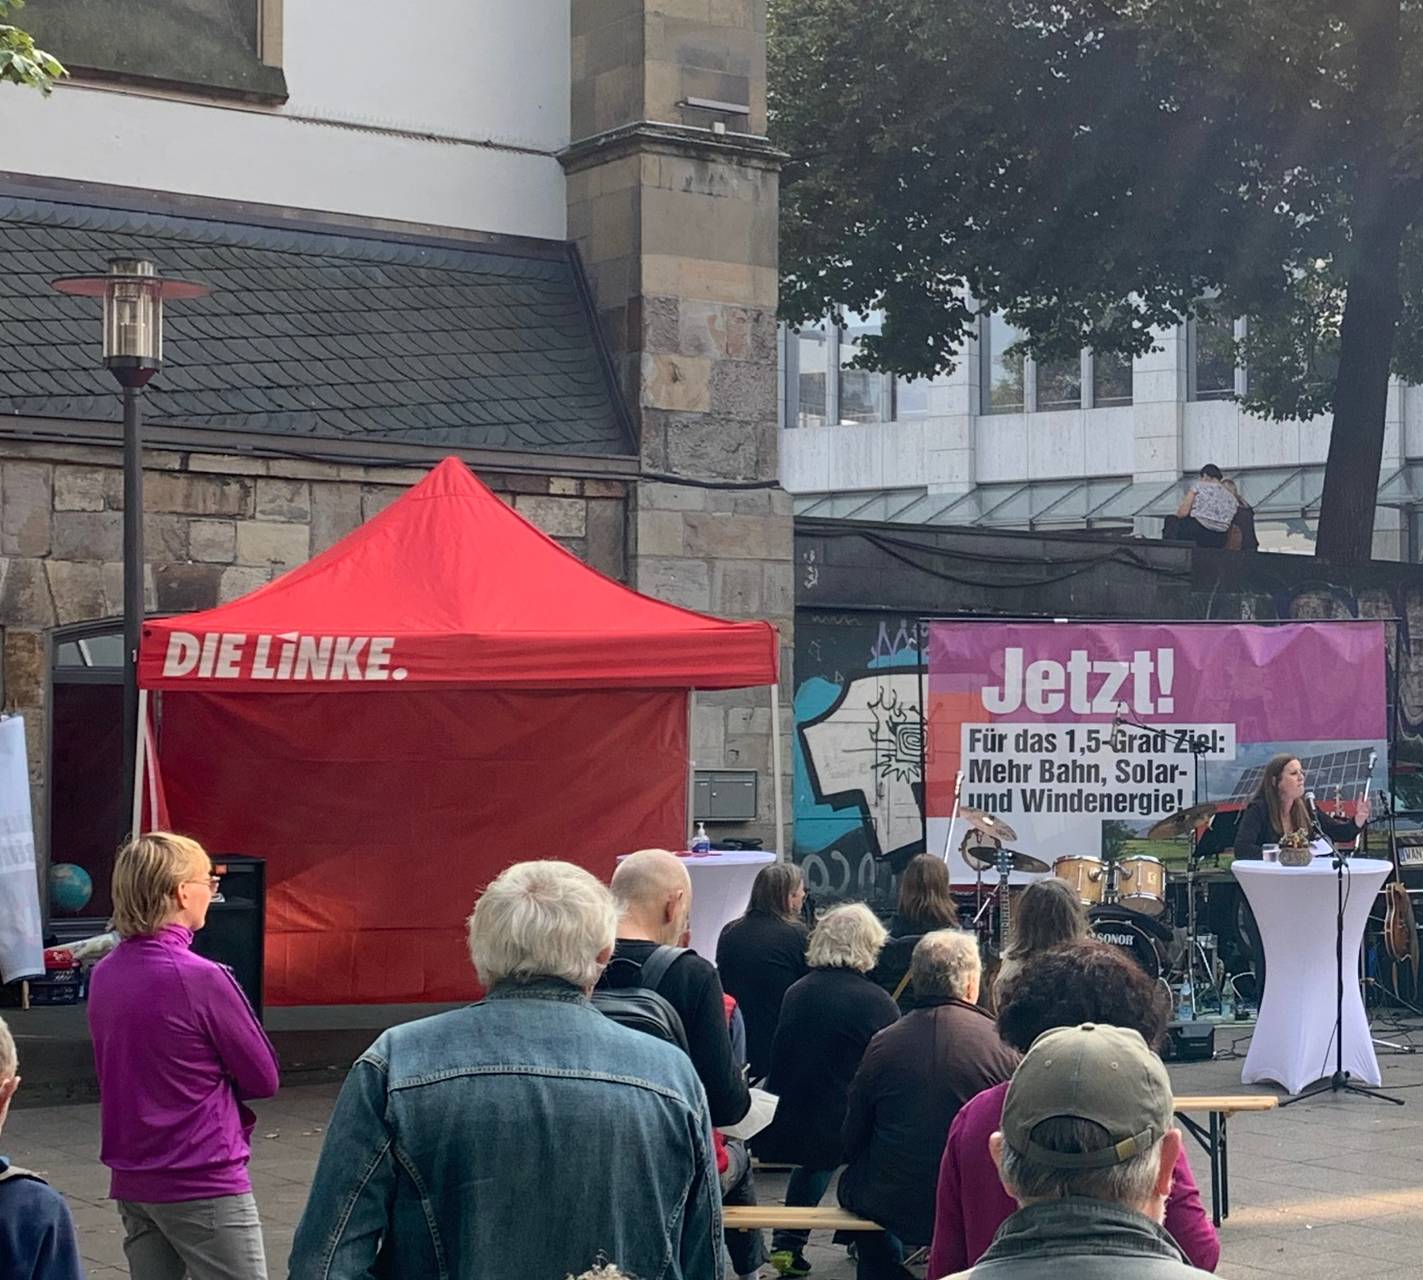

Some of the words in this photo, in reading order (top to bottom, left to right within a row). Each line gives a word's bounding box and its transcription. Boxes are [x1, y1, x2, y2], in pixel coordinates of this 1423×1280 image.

[162, 631, 247, 678] DIE
[981, 647, 1174, 715] Jetzt!
[969, 728, 1007, 753] Für
[1014, 728, 1057, 753] das
[1173, 729, 1225, 754] Ziel:
[968, 759, 1032, 784] Mehr
[1039, 759, 1107, 787] Bahn,
[1115, 759, 1188, 784] Solar-
[968, 788, 1012, 813] und
[1020, 788, 1184, 816] Windenergie!
[1097, 932, 1135, 946] SONOR
